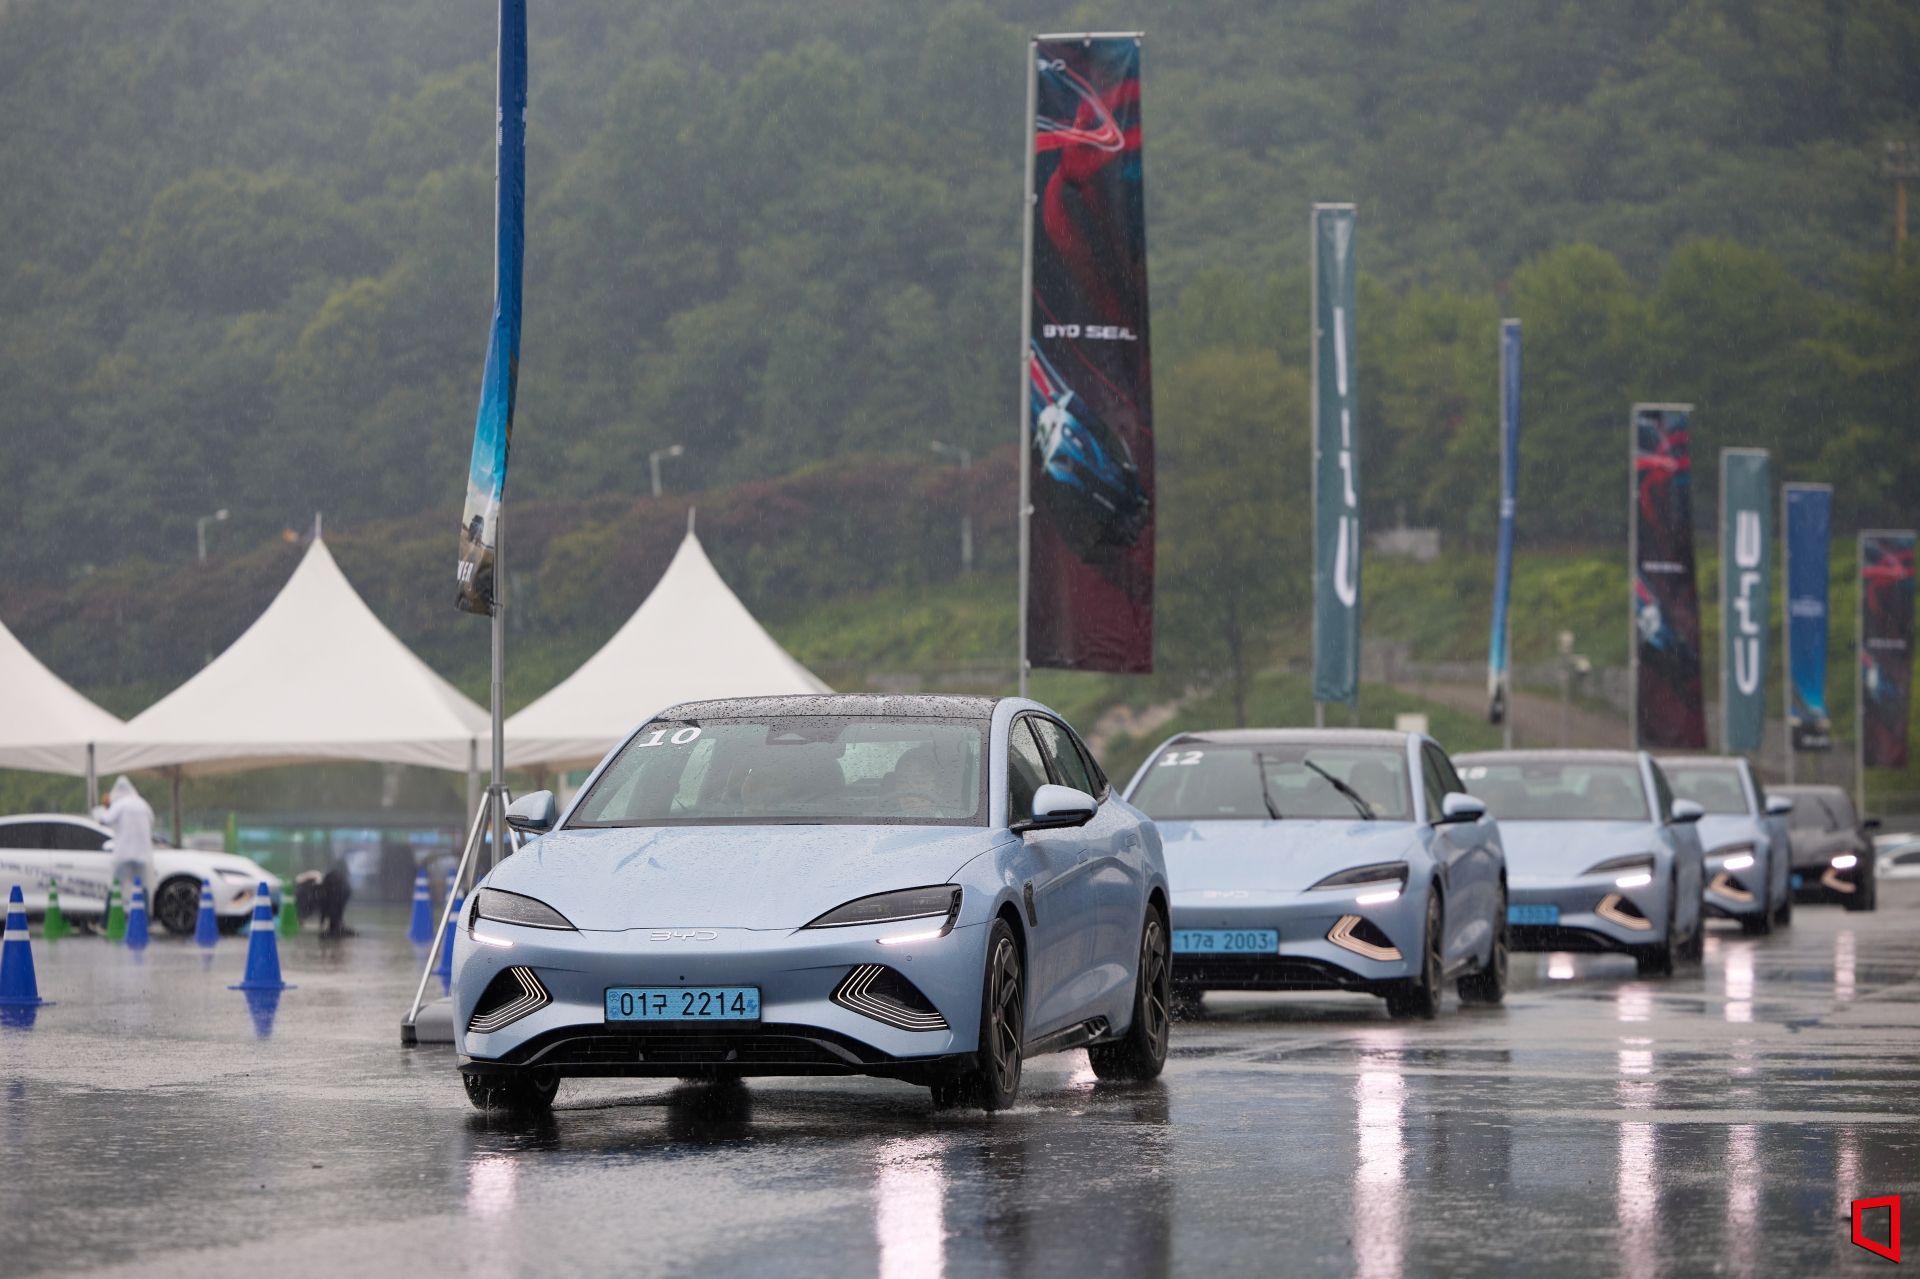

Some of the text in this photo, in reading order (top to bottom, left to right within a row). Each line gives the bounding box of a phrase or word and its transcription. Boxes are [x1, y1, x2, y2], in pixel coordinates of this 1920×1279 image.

[1043, 324, 1138, 341] BYD SEAL
[638, 726, 702, 748] 10
[1159, 750, 1204, 767] 12
[649, 929, 719, 941] BYD
[1223, 932, 1269, 950] 2003
[620, 991, 746, 1016] 01구 2214
